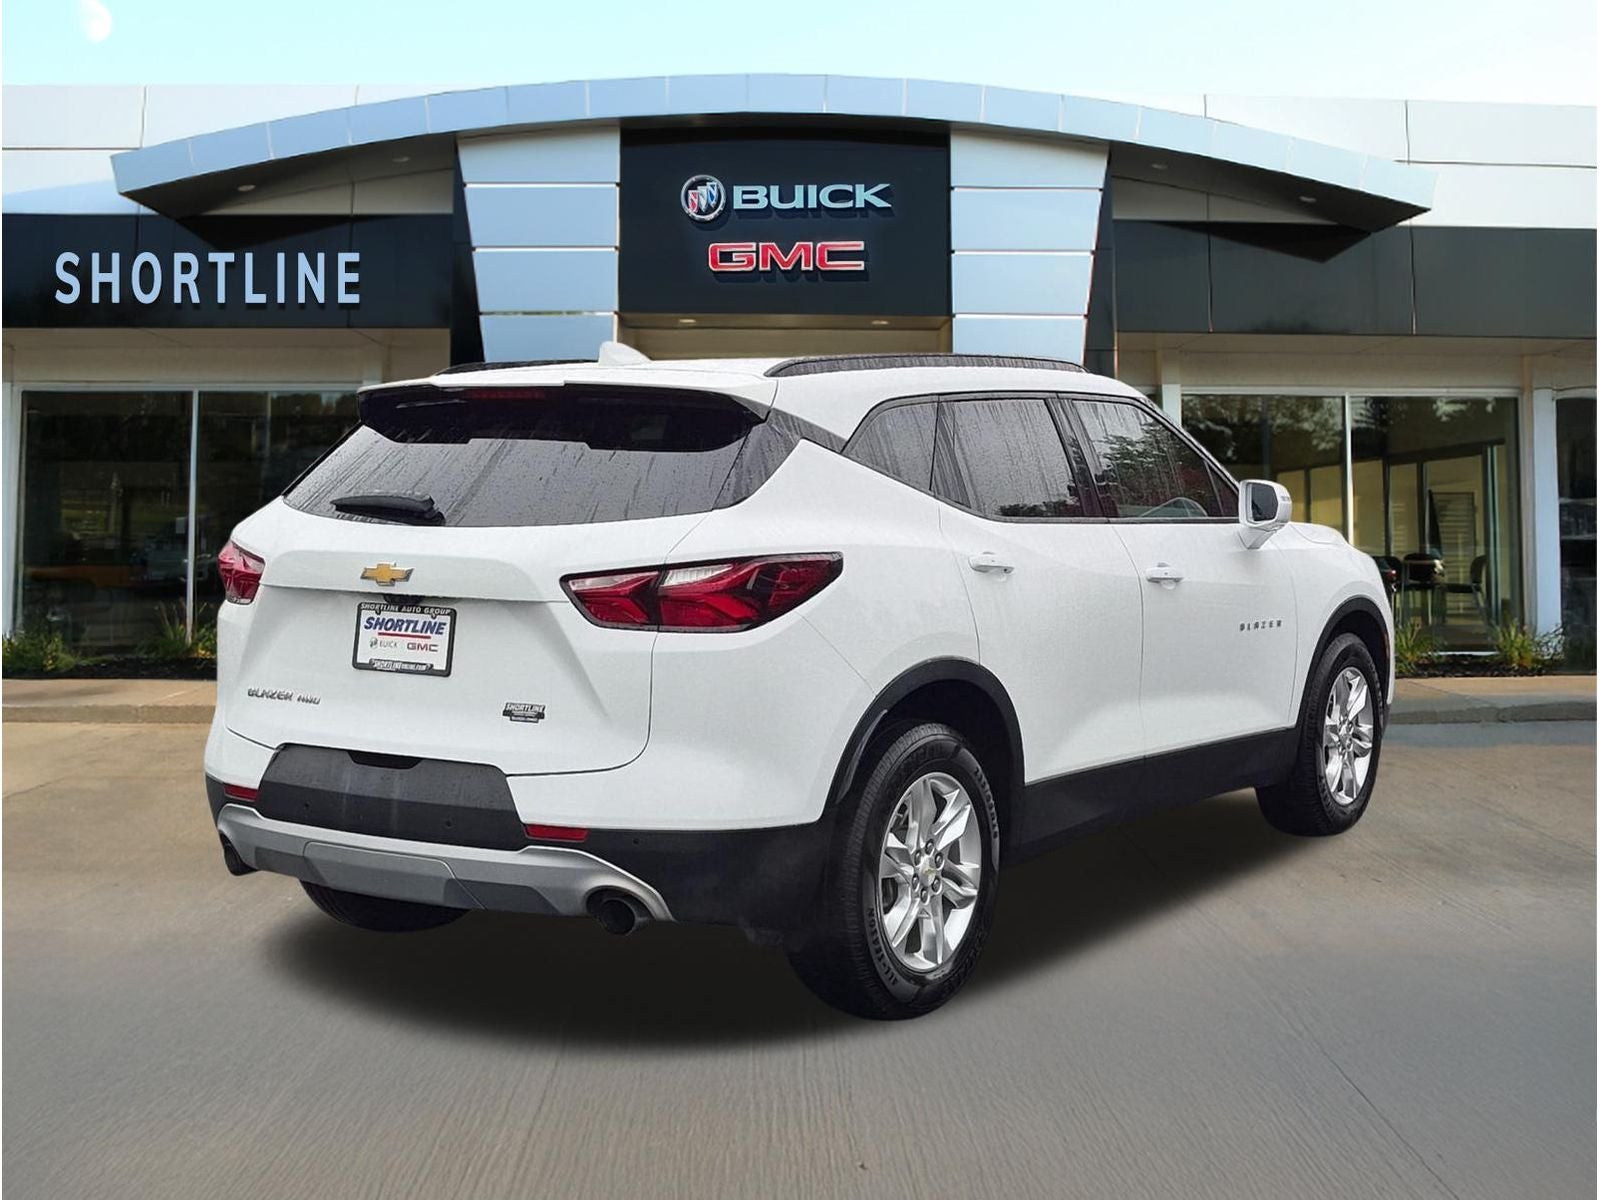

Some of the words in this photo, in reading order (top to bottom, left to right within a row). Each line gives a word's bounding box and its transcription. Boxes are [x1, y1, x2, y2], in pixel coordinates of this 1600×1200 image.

[732, 183, 893, 210] BUICK
[708, 240, 865, 272] GMC
[54, 251, 361, 304] SHORTLINE
[360, 602, 399, 611] SHORTLINE
[424, 607, 451, 615] GROUP
[363, 616, 447, 635] SHORTLINE
[406, 642, 439, 652] GMC
[247, 687, 293, 701] BLAZER
